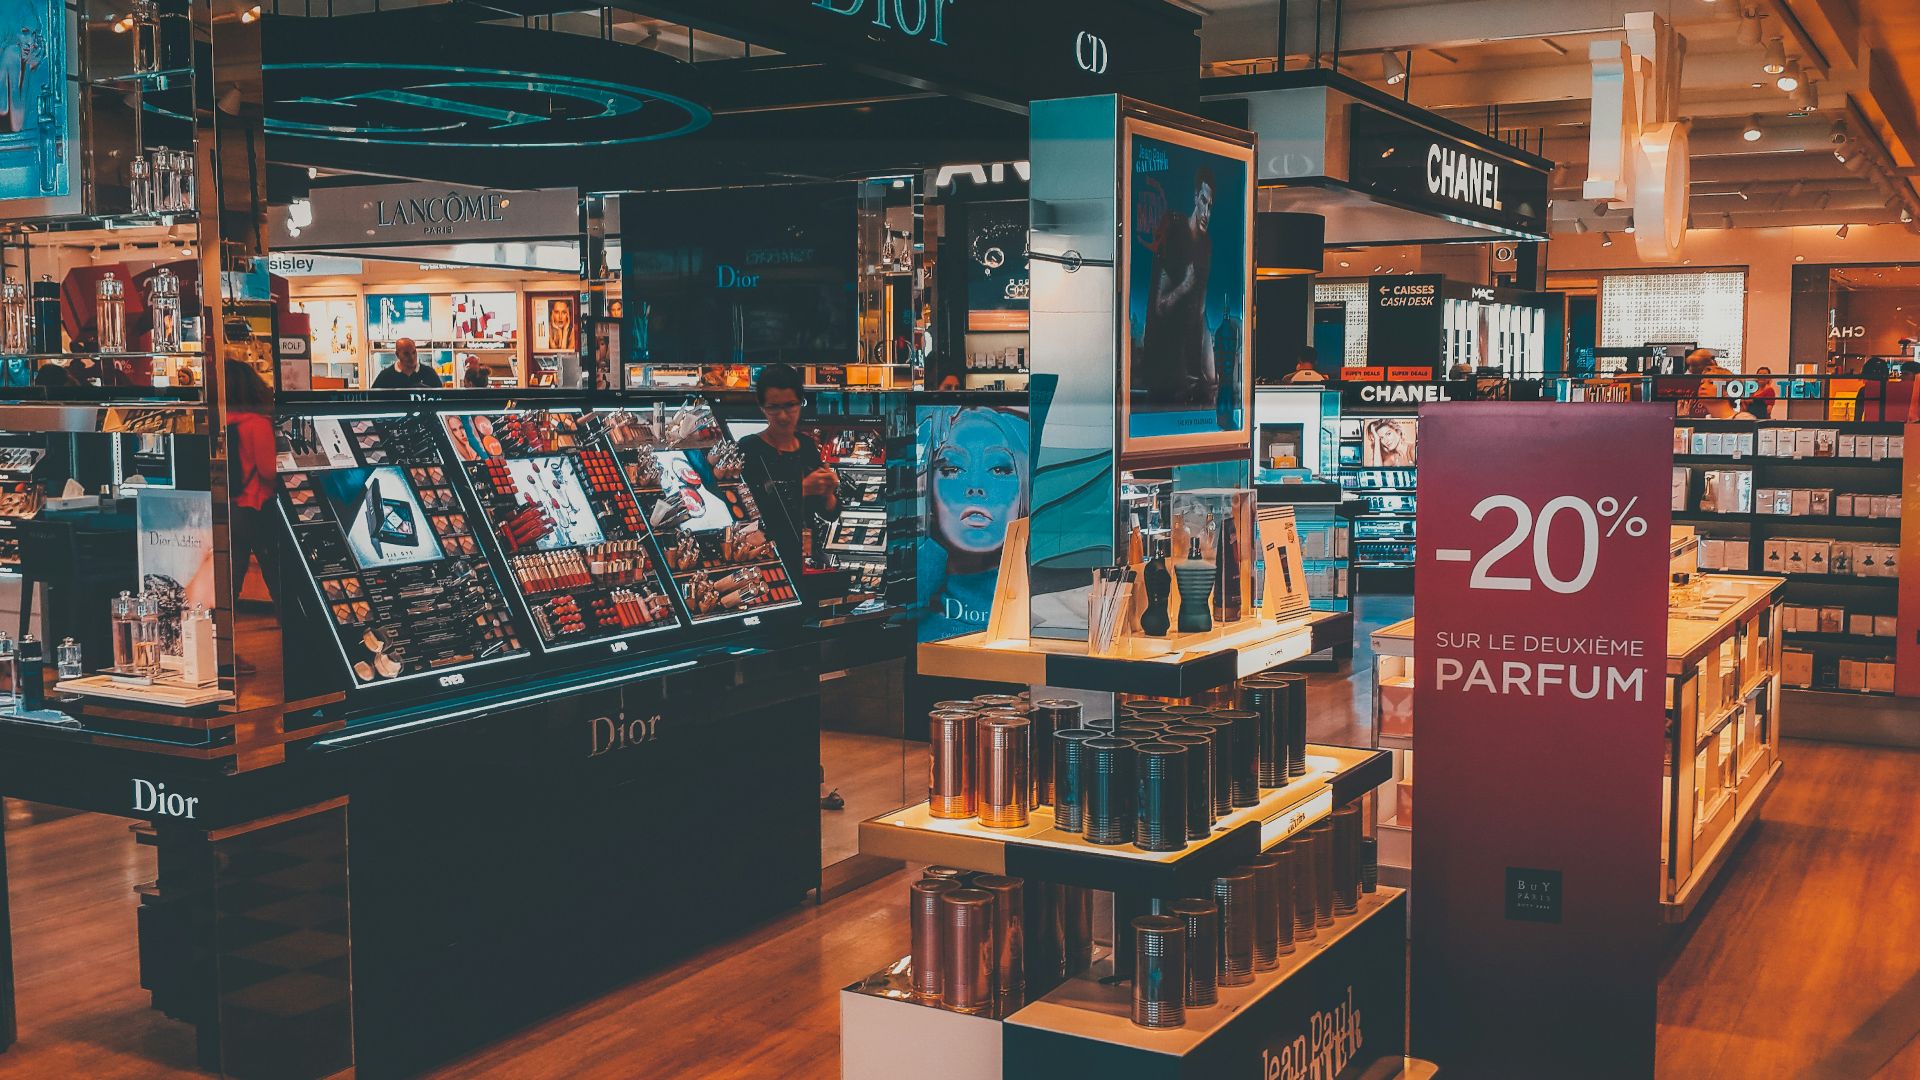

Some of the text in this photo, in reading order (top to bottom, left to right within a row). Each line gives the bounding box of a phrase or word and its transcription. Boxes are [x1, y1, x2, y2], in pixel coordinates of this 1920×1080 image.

[1427, 144, 1503, 211] CHANEL
[377, 191, 503, 227] LANCÔME
[270, 256, 314, 272] sisley
[717, 264, 760, 288] Dior
[1381, 296, 1433, 306] CASH DESK
[1394, 285, 1434, 294] CAISSES
[1361, 386, 1451, 402] CHANEL
[1713, 381, 1820, 398] TOP TEN
[150, 531, 171, 546] Dior
[1436, 495, 1648, 594] -20%
[944, 597, 989, 622] Dior
[1436, 632, 1645, 656] SUR LE DEUXIÈME
[587, 714, 661, 758] Dior
[131, 778, 199, 819] Dior
